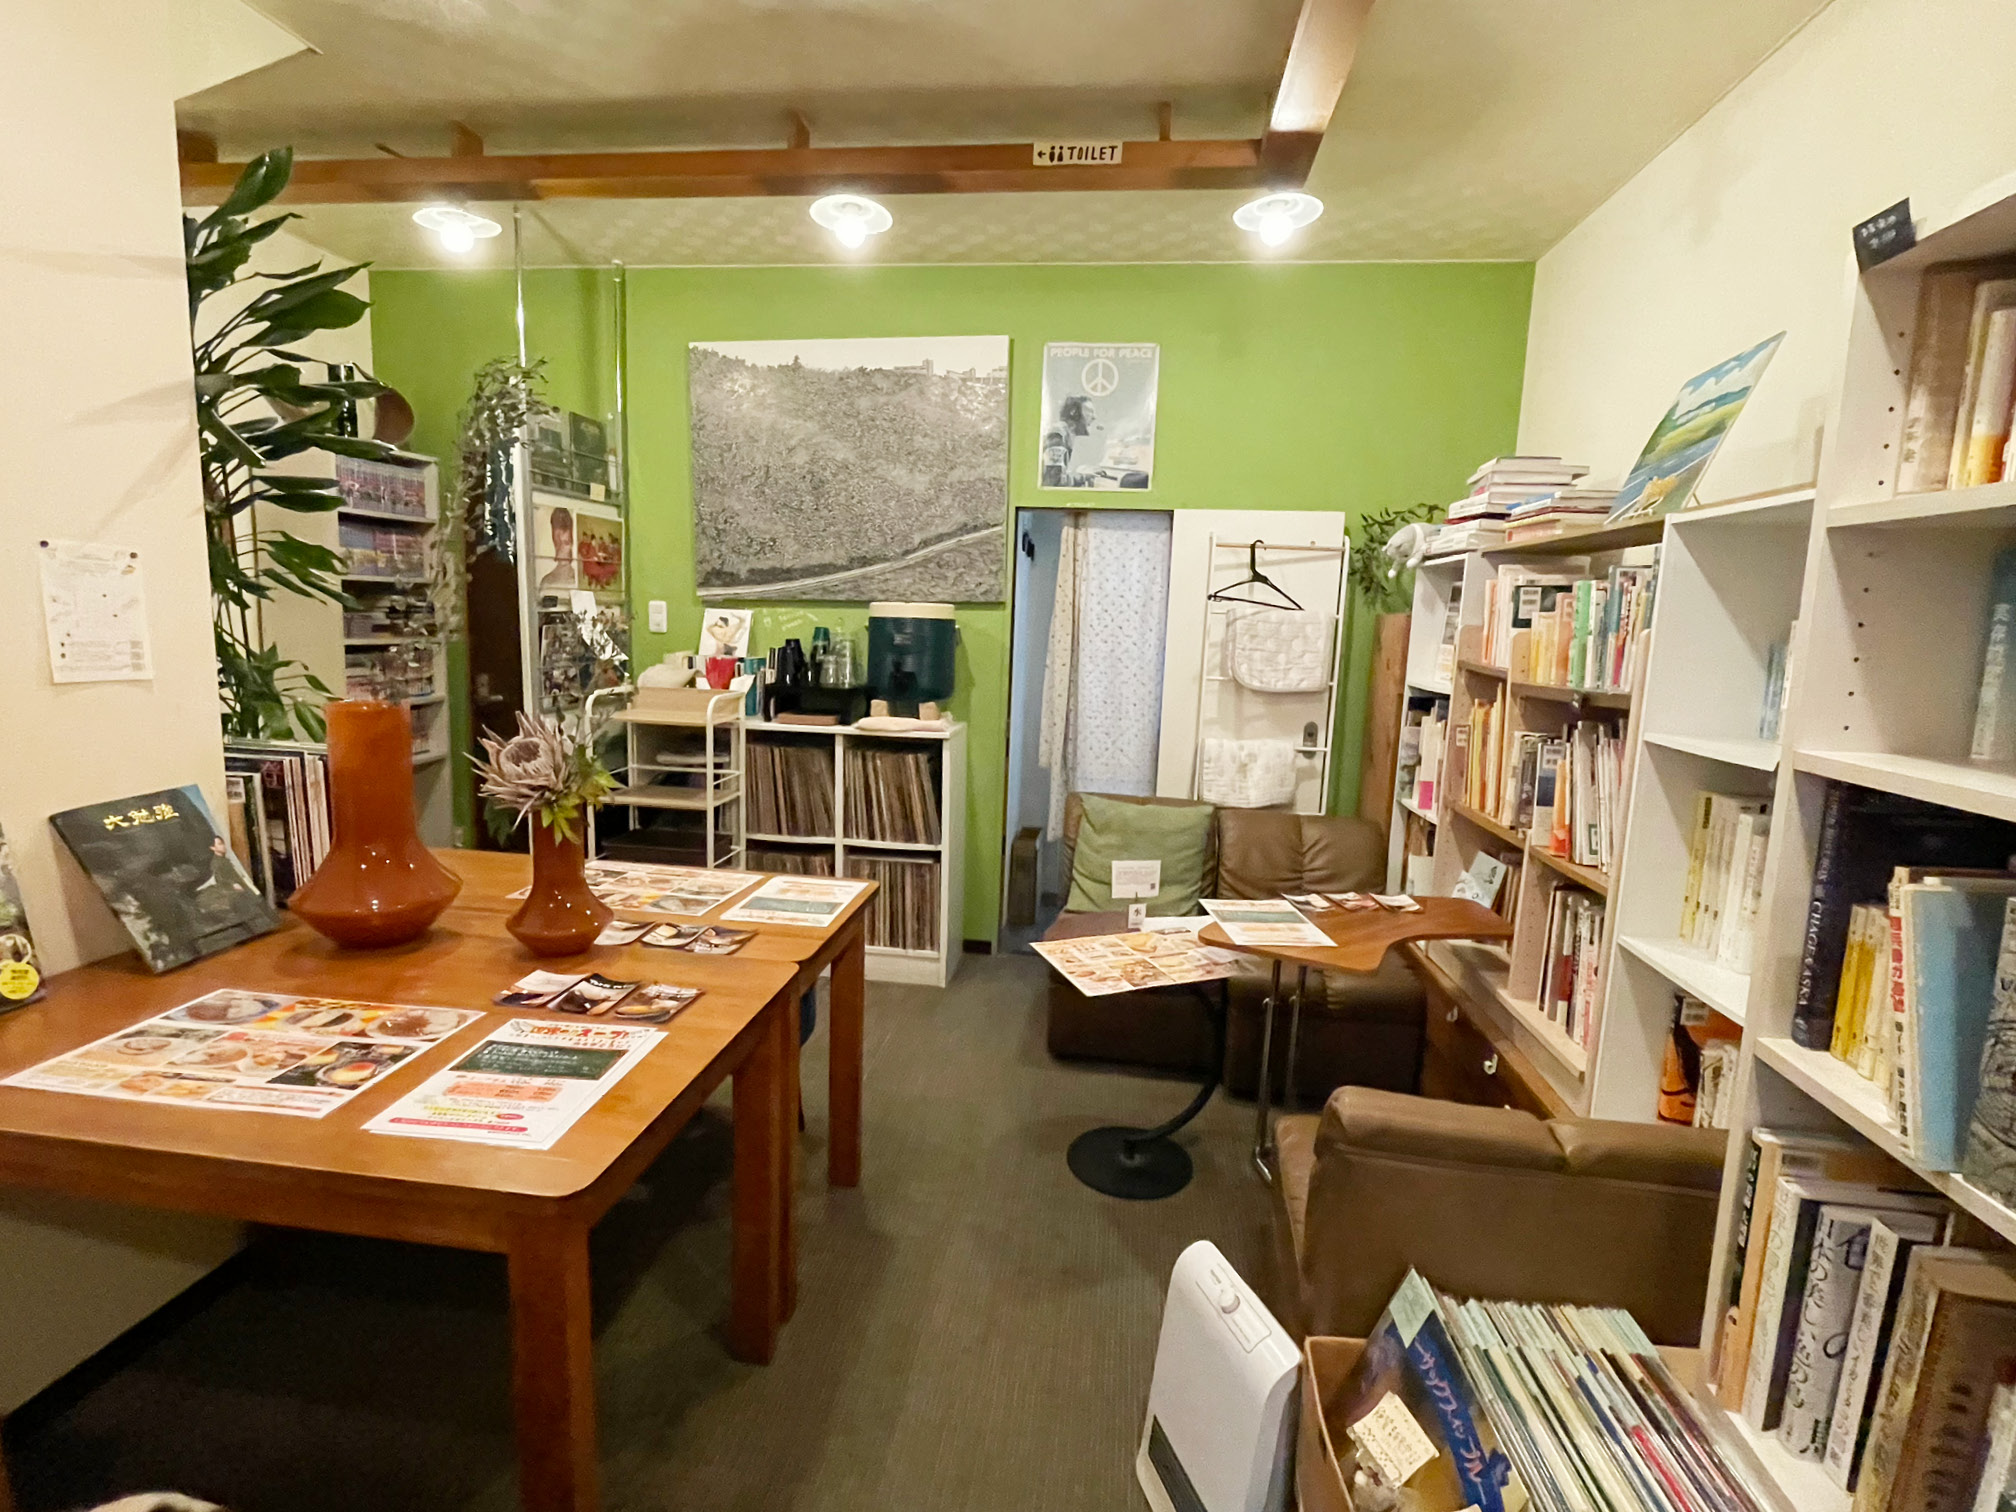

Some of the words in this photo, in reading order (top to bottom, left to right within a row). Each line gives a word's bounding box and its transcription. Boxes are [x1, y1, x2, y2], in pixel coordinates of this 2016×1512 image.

[1067, 145, 1118, 161] TOILET
[1050, 347, 1090, 358] PEOPLE
[1093, 348, 1115, 358] FOR
[1118, 349, 1153, 359] PEACE
[103, 803, 180, 831] 大勉強
